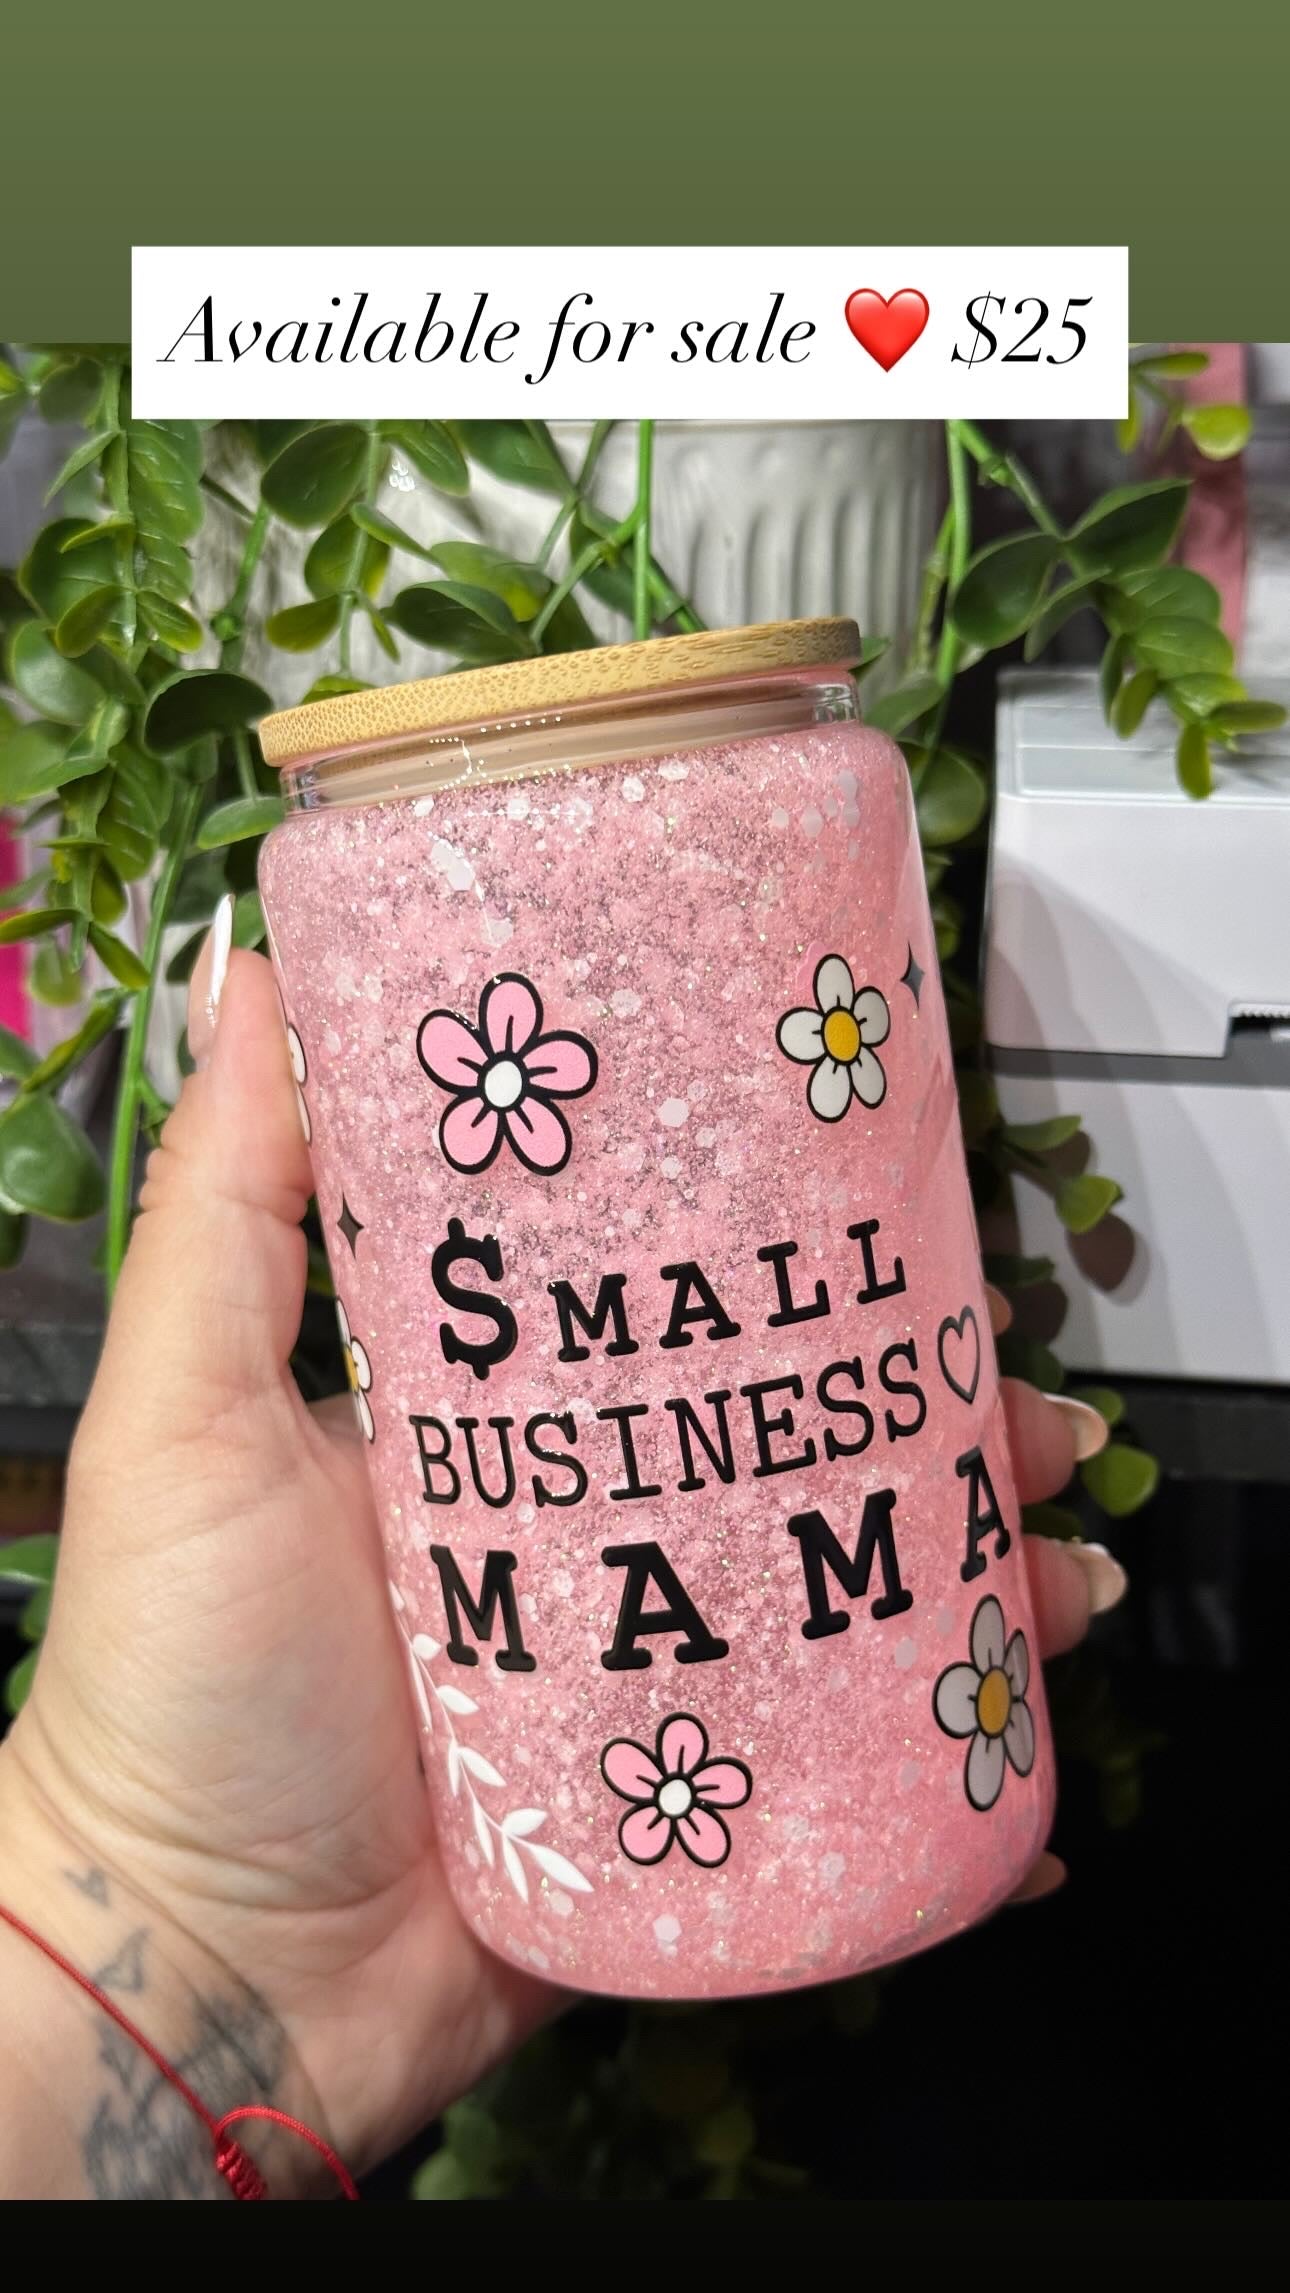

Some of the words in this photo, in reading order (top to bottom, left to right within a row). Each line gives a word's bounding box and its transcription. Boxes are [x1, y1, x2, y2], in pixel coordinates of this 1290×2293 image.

[430, 1217, 908, 1381] $MALL
[409, 1337, 928, 1508] BUSINESS
[429, 1446, 1012, 1673] MAMA
